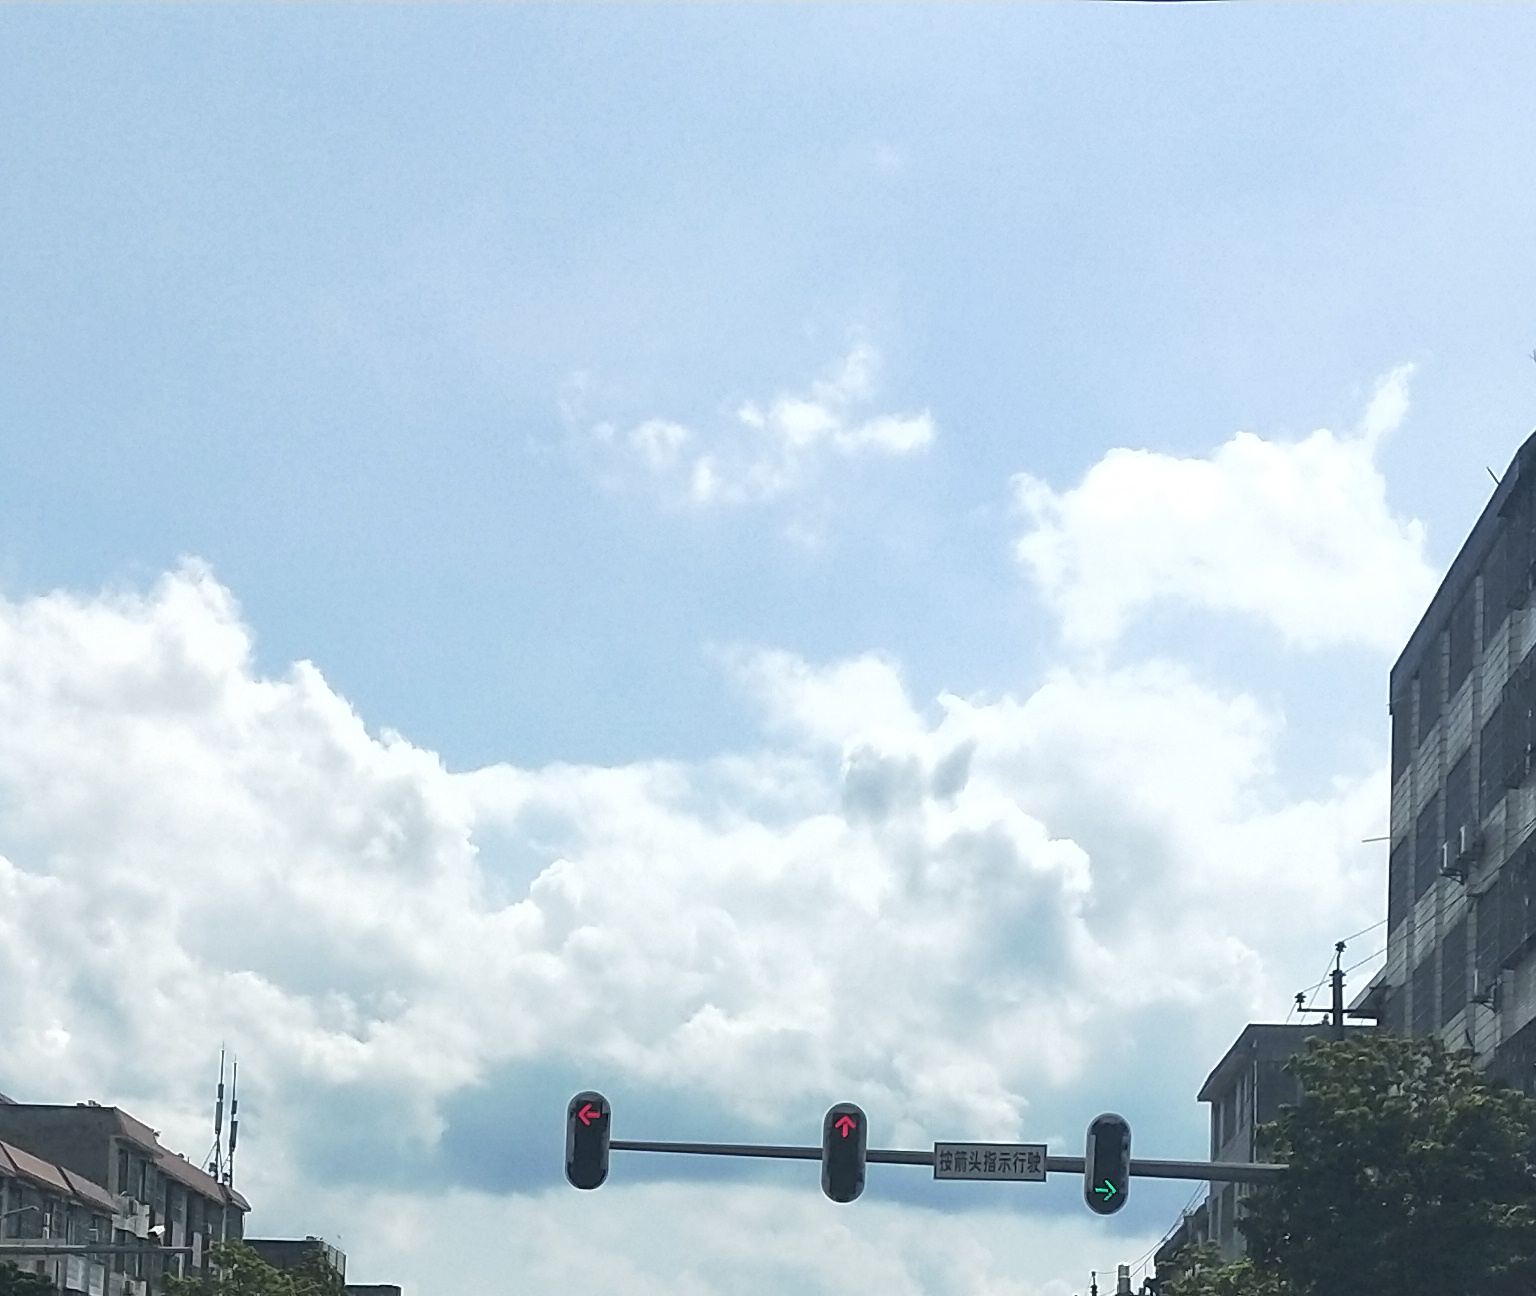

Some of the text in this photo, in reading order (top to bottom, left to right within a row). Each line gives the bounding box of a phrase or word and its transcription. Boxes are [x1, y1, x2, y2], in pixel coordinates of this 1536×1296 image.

[939, 1150, 1042, 1174] 按箭头指示行驶
